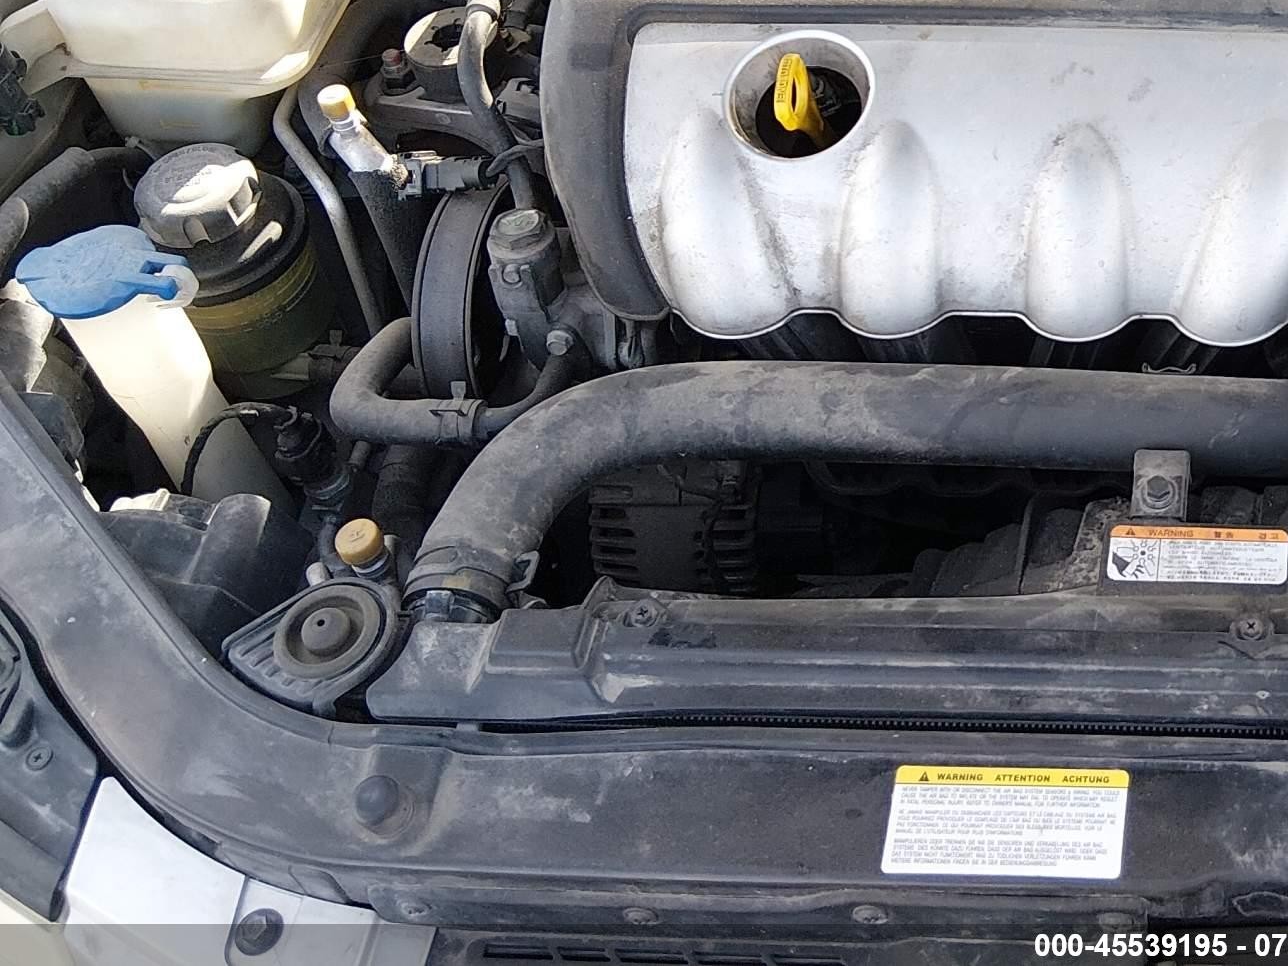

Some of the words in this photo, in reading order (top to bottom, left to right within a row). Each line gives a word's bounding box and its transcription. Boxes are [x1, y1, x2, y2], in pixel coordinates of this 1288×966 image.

[1150, 530, 1194, 538] WARNING
[937, 773, 984, 781] WARNING
[995, 774, 1051, 782] ATTENTION
[1062, 775, 1110, 784] ACHTUNG
